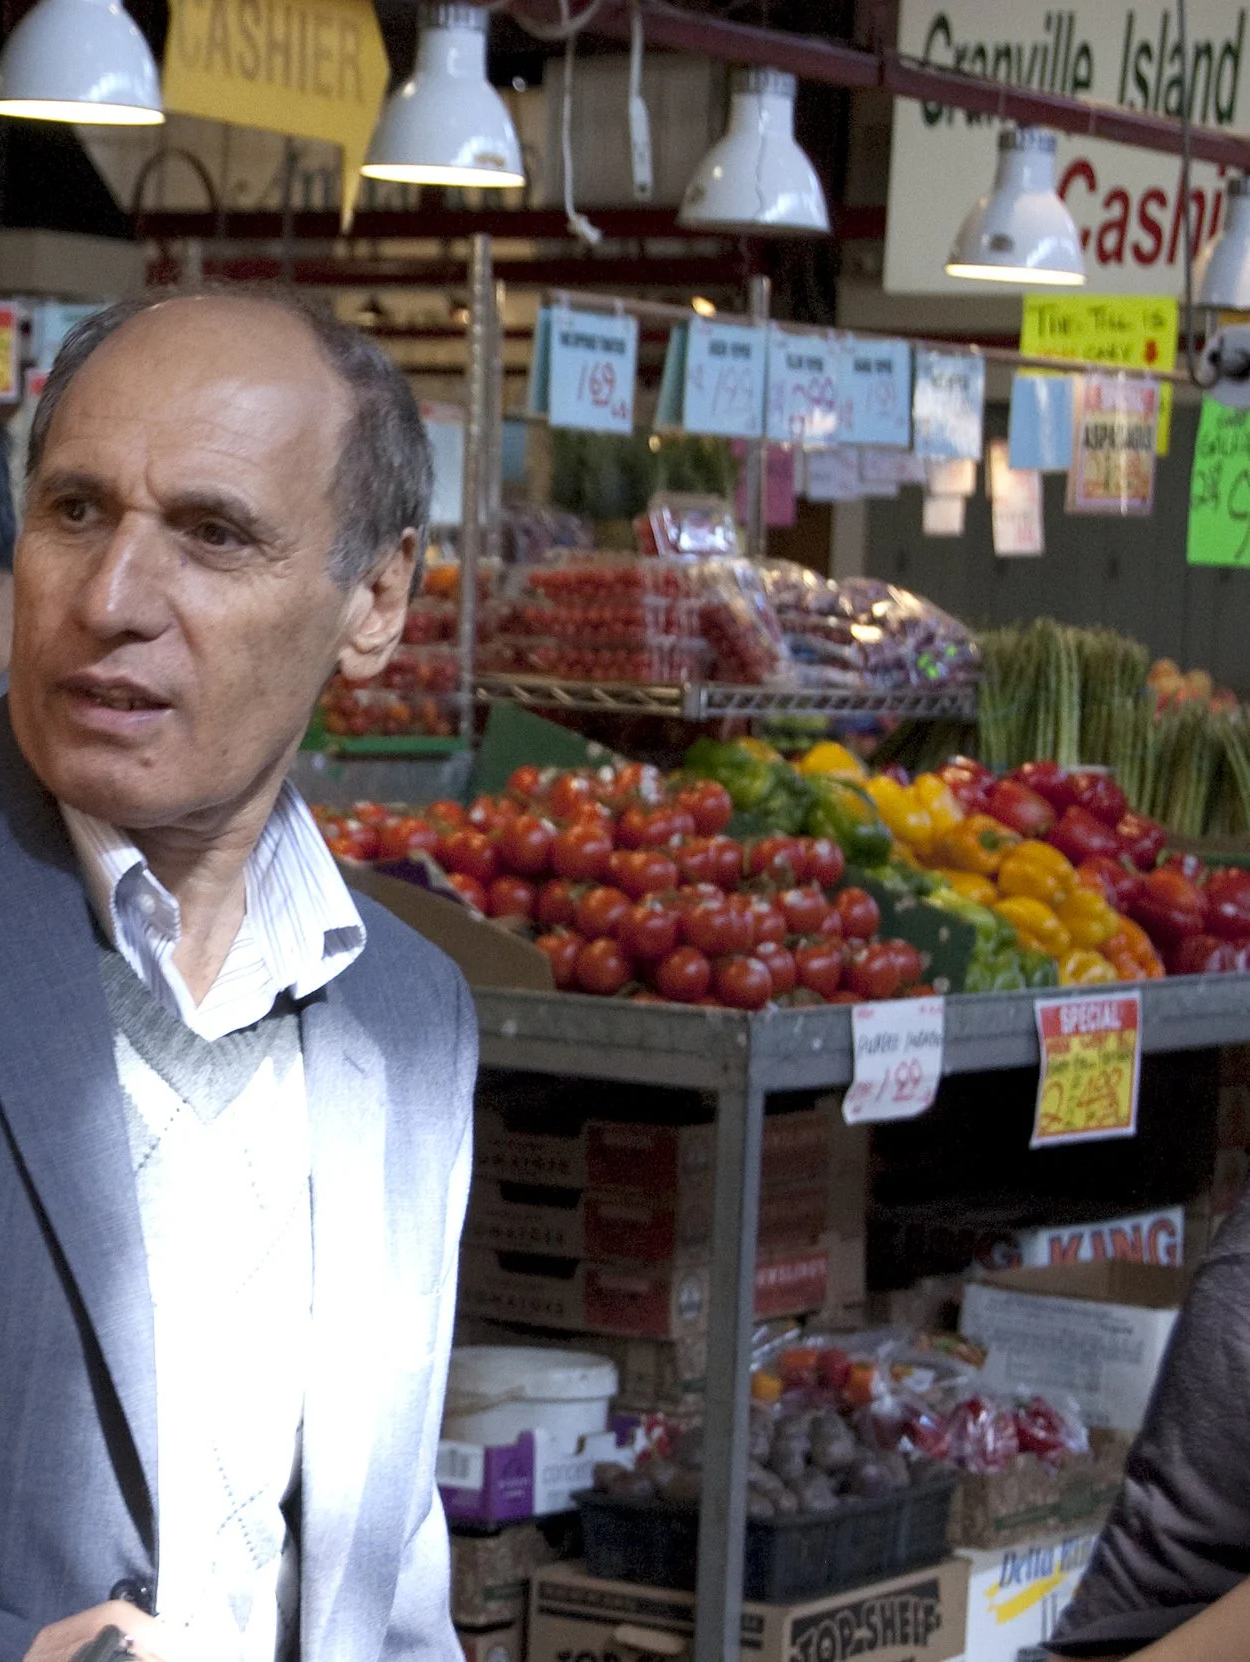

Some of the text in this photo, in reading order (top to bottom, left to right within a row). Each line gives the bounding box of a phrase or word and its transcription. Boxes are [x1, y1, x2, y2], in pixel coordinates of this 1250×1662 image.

[176, 0, 365, 104] CASHIER
[1116, 6, 1247, 126] Island
[1060, 1001, 1122, 1033] SPECIAL
[1048, 1216, 1179, 1269] KING
